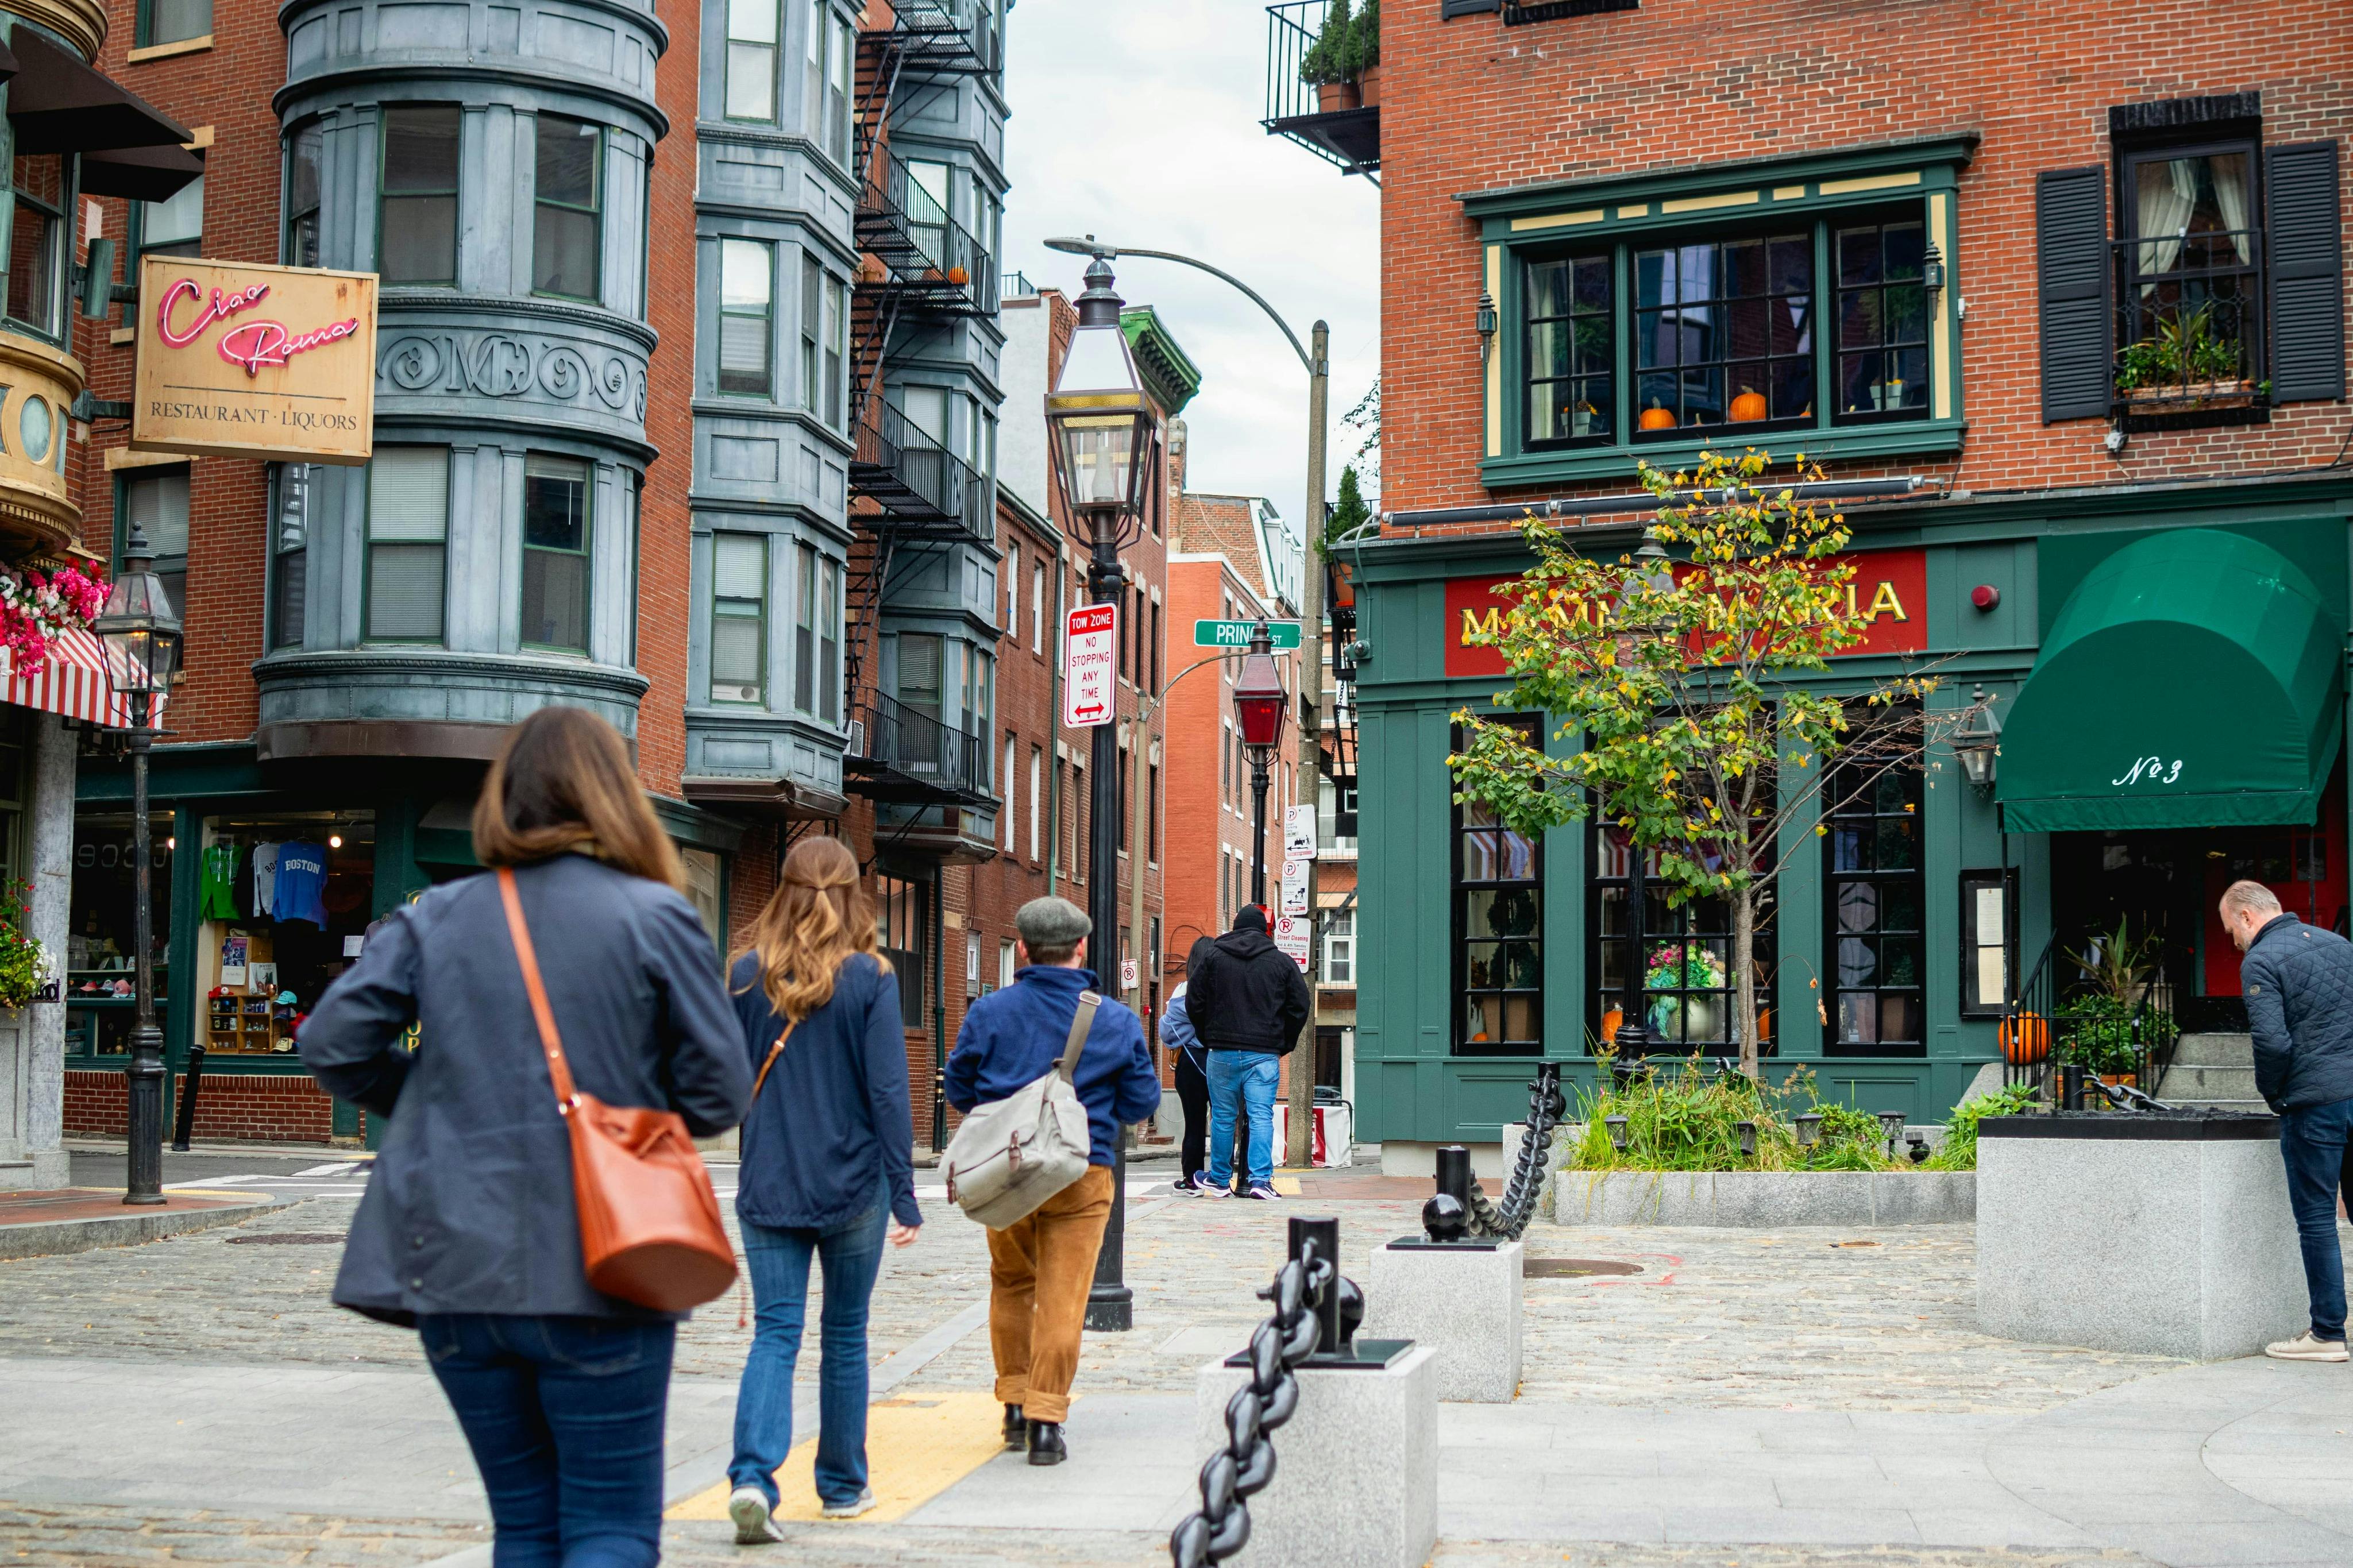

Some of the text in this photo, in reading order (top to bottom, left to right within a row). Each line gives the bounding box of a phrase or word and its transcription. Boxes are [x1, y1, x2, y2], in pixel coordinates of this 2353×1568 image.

[157, 279, 270, 348] Ciao
[217, 318, 360, 377] Roma
[151, 402, 357, 431] RESTAURANT LIQUORS
[1071, 613, 1111, 629] TOW ZONE
[1086, 636, 1097, 648] NO
[1216, 624, 1282, 645] PRIN ST
[1072, 651, 1109, 667] STOPPING
[1082, 670, 1098, 683] ANY
[1081, 687, 1098, 700] TIME
[2162, 759, 2183, 784] 3
[285, 859, 321, 875] BOSTON
